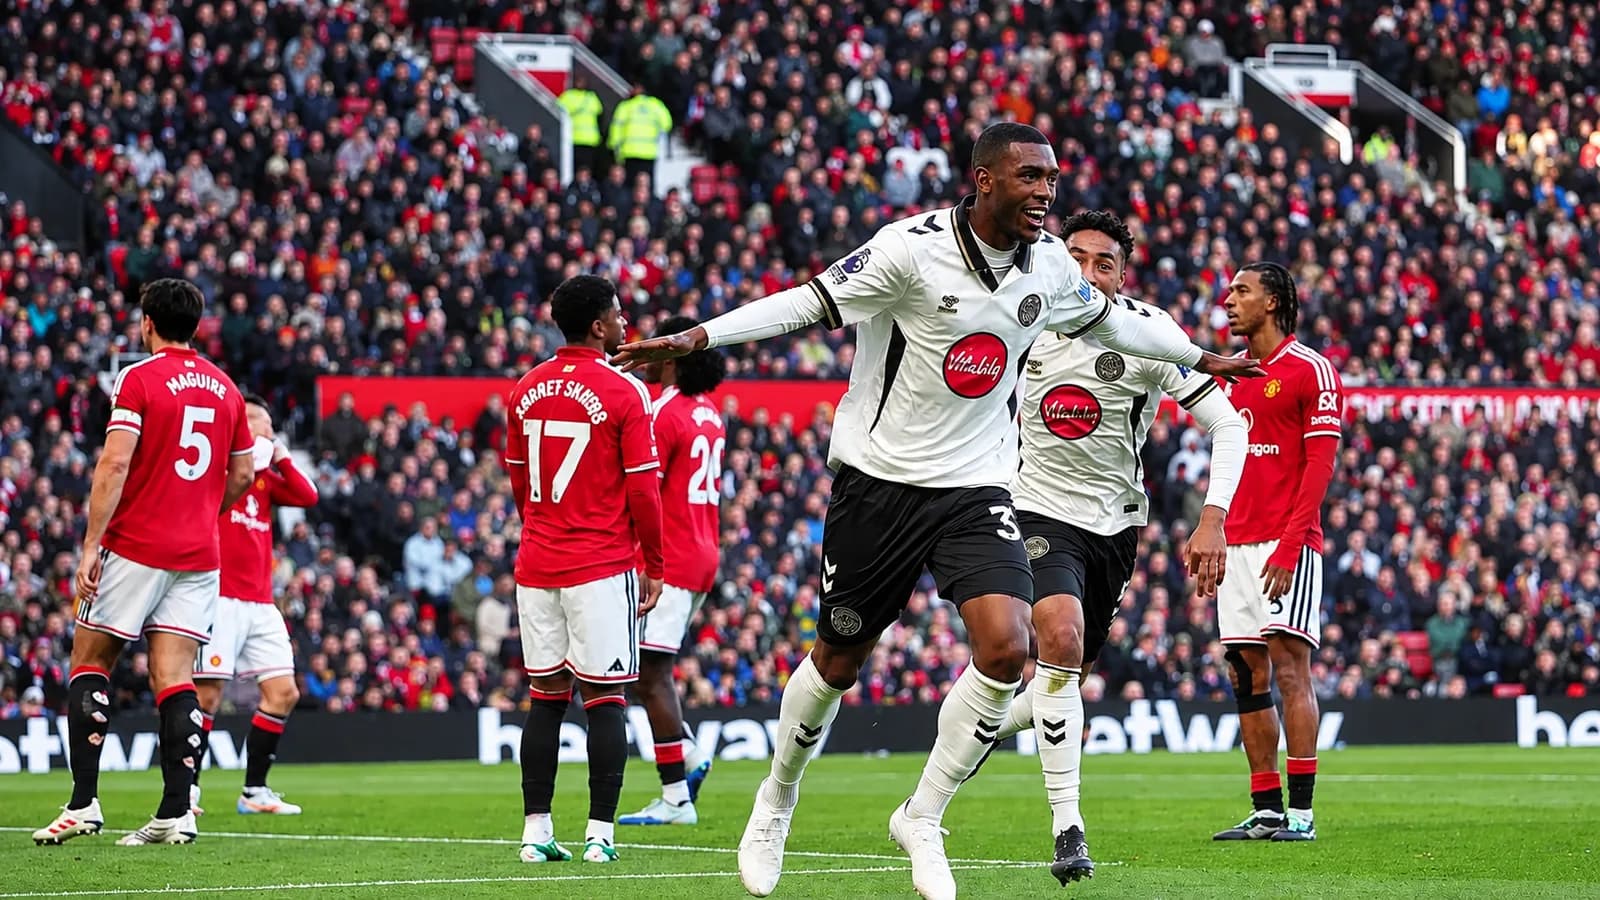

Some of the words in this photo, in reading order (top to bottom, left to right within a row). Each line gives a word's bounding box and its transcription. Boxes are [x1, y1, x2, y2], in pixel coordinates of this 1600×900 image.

[166, 371, 227, 400] MAGUIRE
[174, 405, 215, 481] 5
[523, 419, 591, 504] 17
